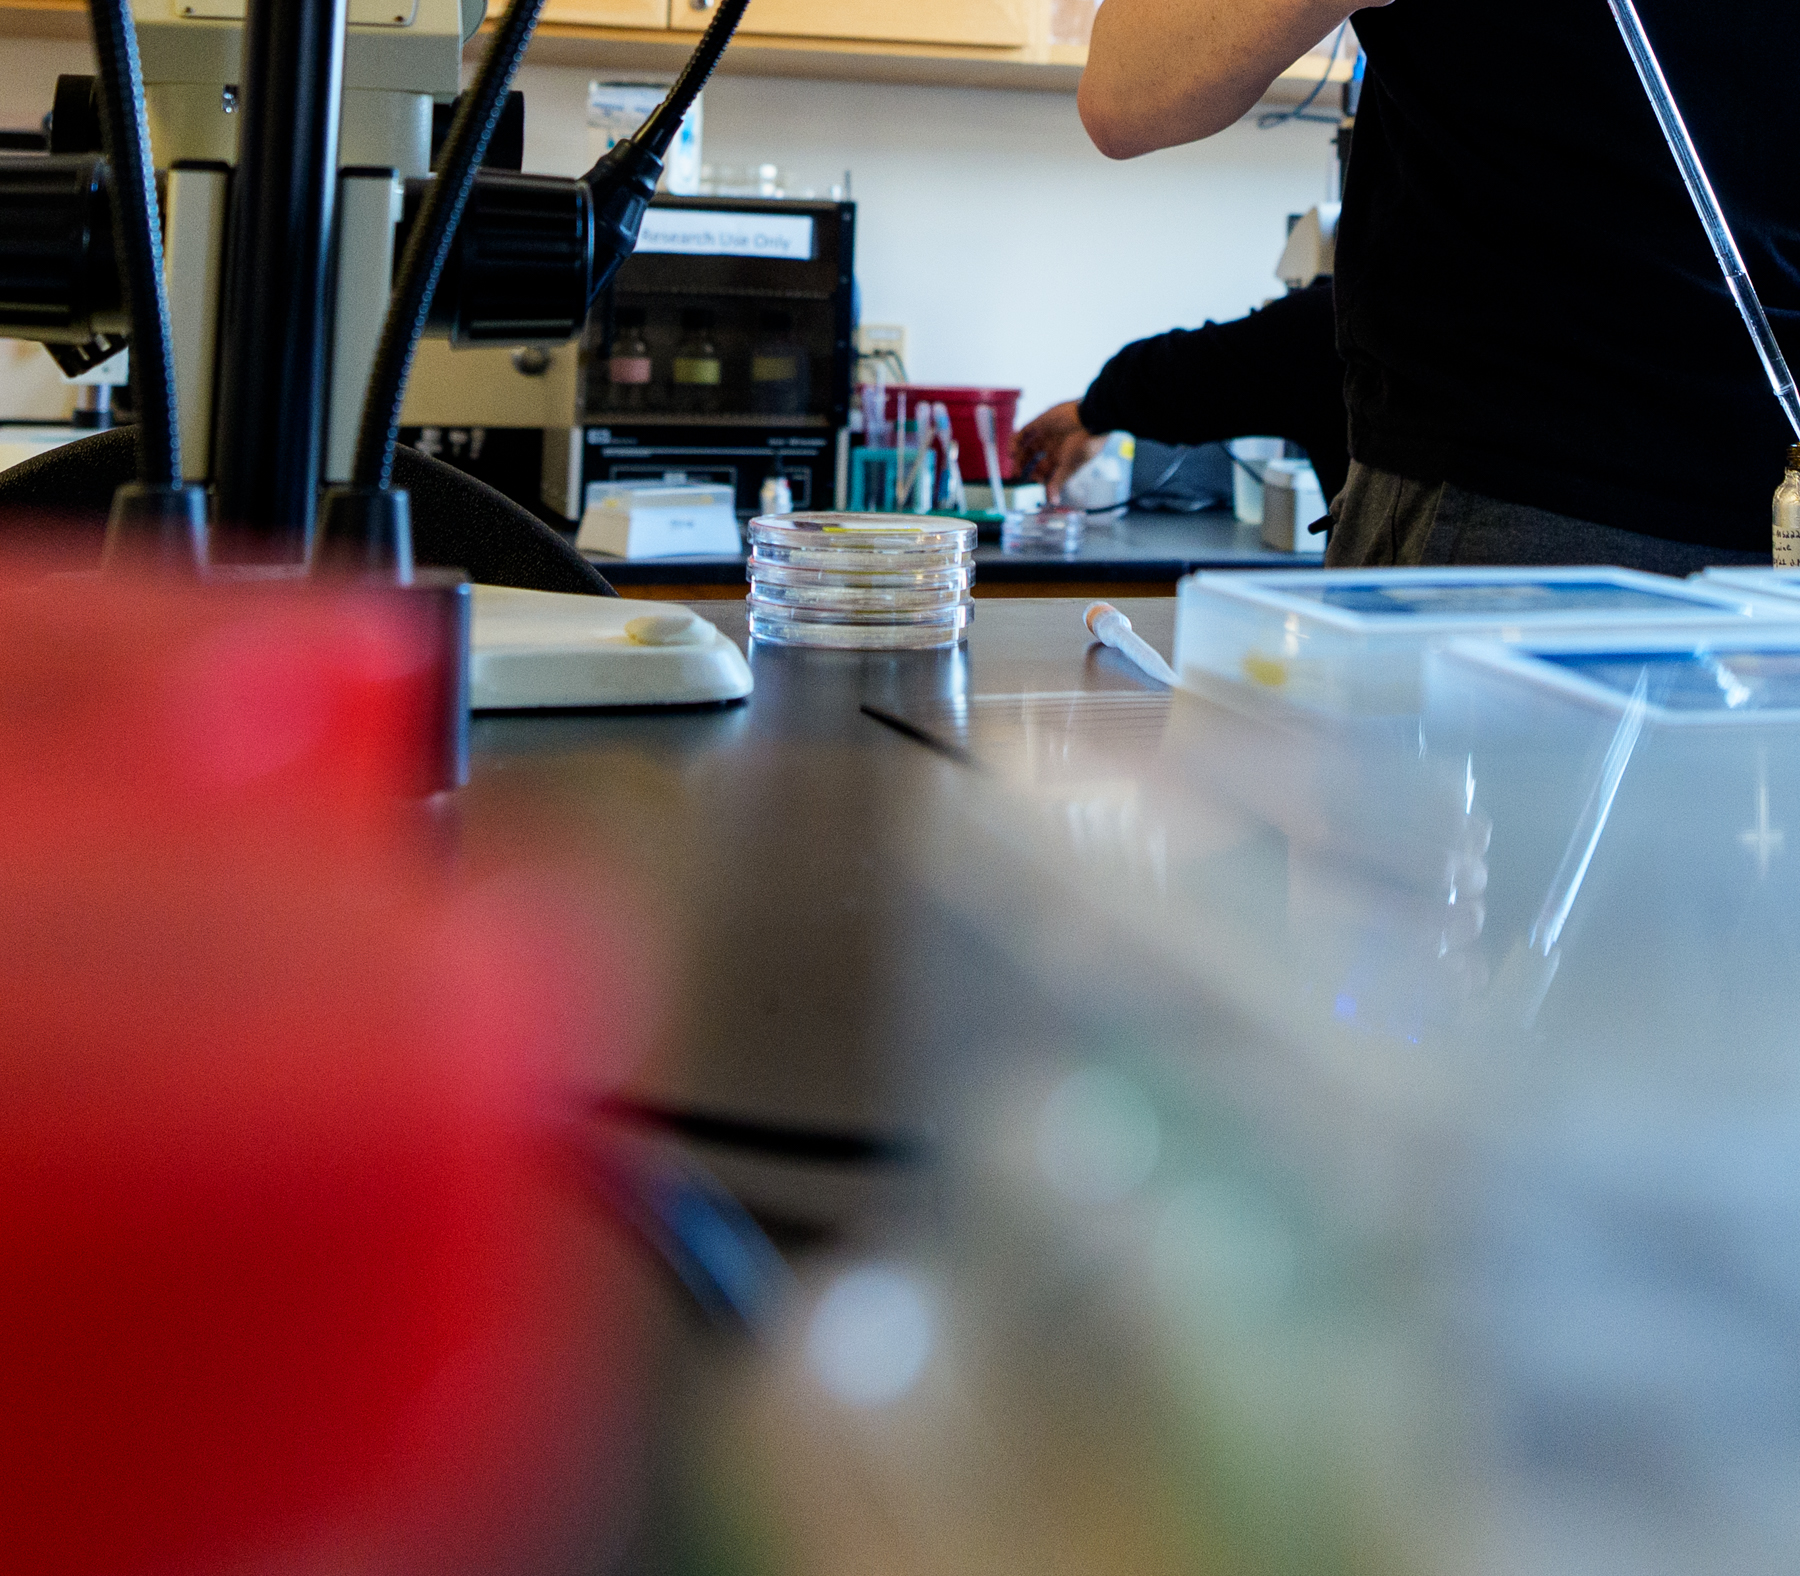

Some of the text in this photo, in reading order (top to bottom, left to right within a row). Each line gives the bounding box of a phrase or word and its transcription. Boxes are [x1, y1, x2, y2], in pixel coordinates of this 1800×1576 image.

[641, 228, 791, 252] Research Use Only
